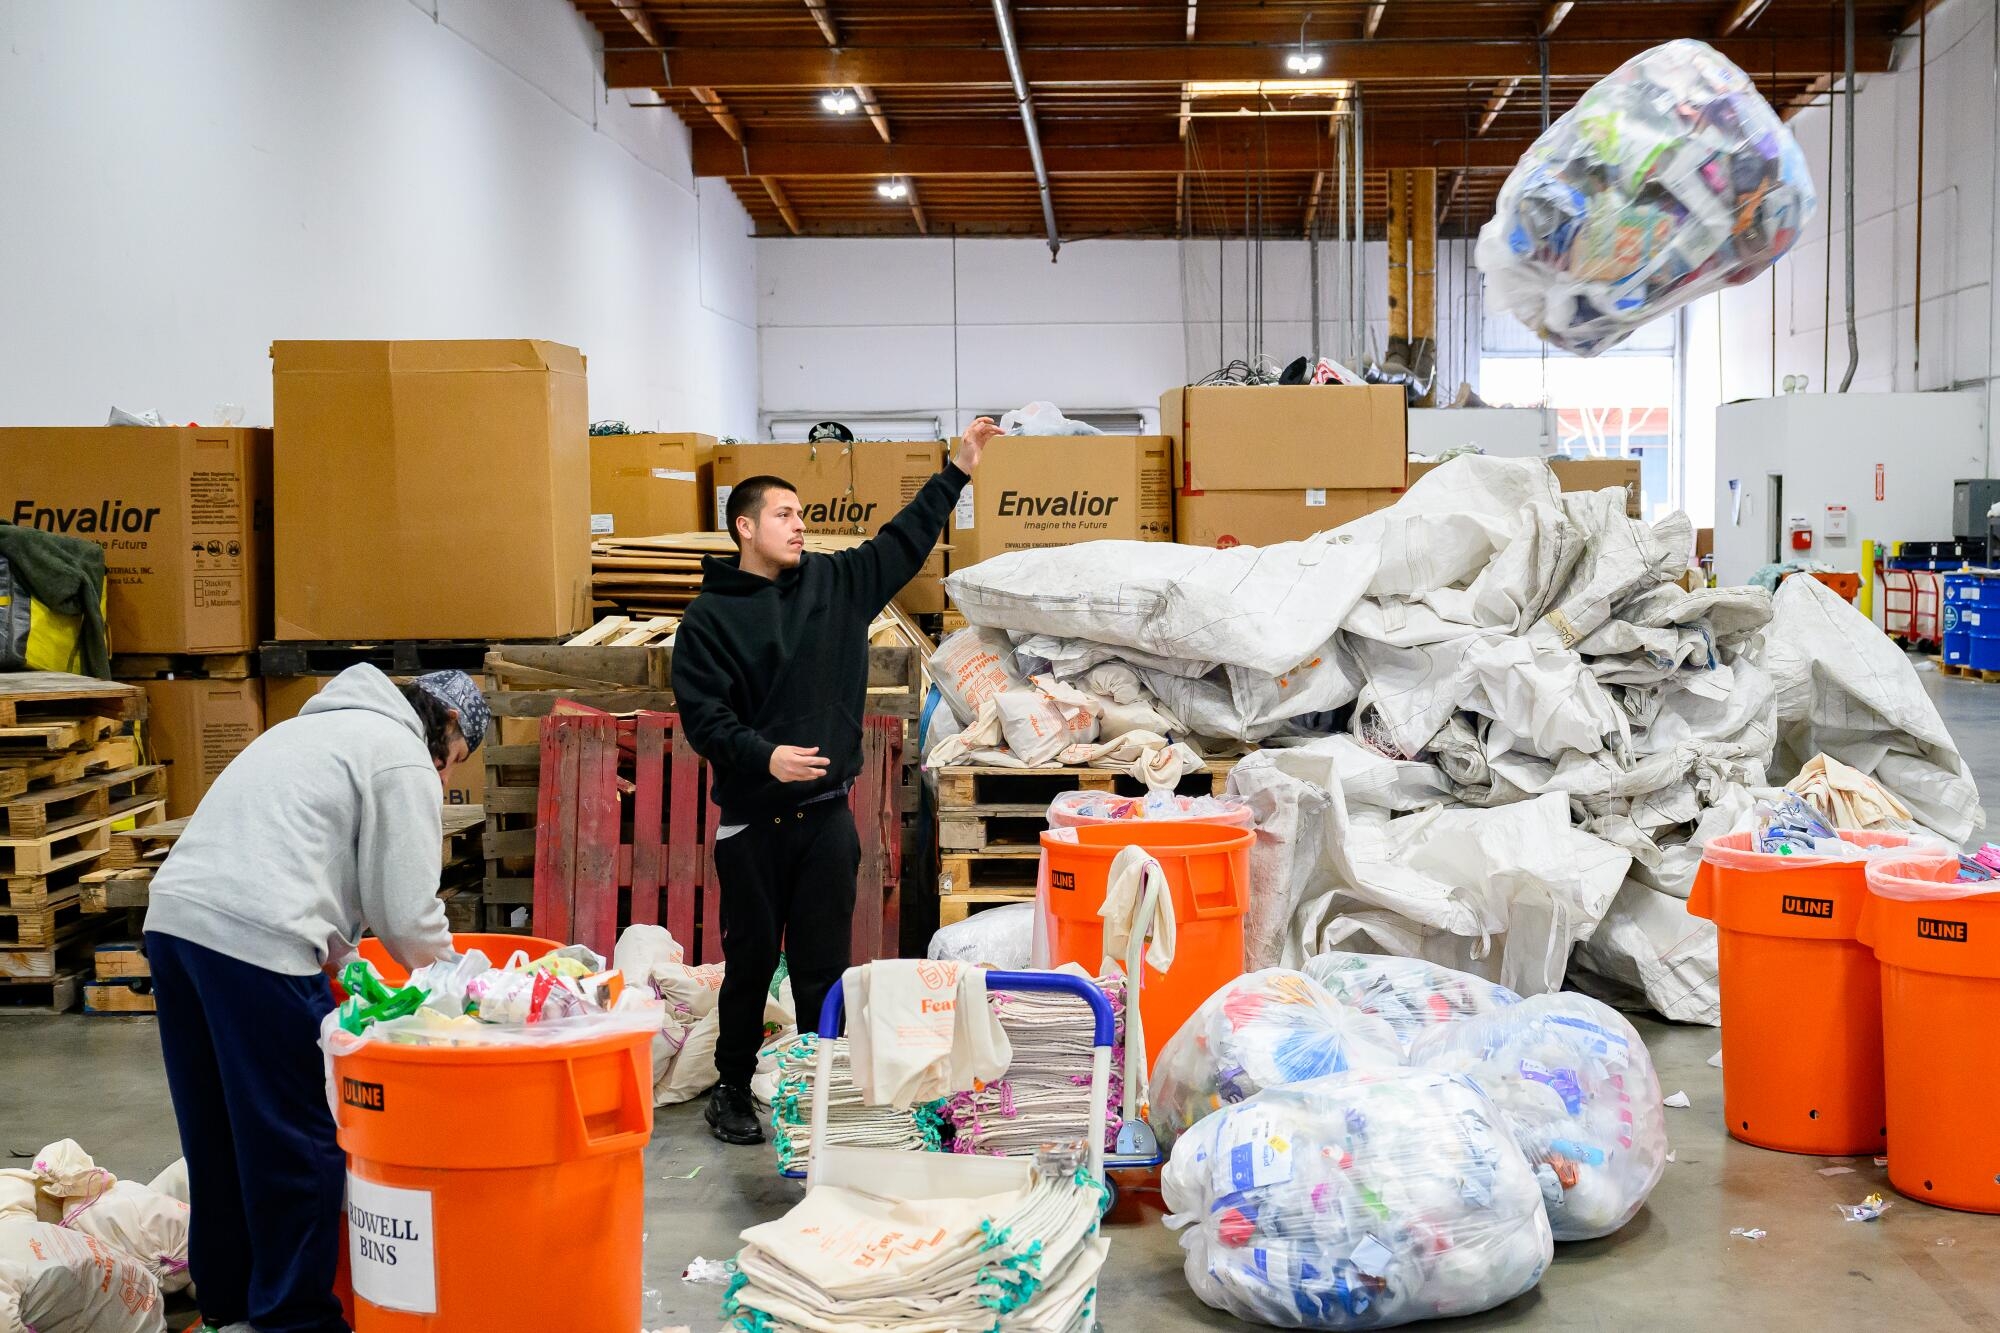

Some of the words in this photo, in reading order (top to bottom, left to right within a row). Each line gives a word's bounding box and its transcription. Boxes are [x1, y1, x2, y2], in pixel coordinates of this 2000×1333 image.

[802, 497, 878, 522] valior
[998, 491, 1119, 517] Envalior
[13, 500, 161, 533] Envalior
[1024, 521, 1060, 531] Imagine
[1062, 521, 1077, 529] the
[1078, 521, 1108, 529] Future
[111, 539, 148, 550] Future
[204, 579, 231, 588] Stacking
[956, 654, 999, 692] Multi-layer
[957, 652, 987, 676] Plastic
[1053, 872, 1074, 888] ULINE
[1785, 898, 1831, 916] ULINE
[1919, 921, 1965, 939] ULINE
[344, 1080, 382, 1107] ULINE
[348, 1201, 419, 1241] RIDWELL
[360, 1235, 397, 1266] BINS
